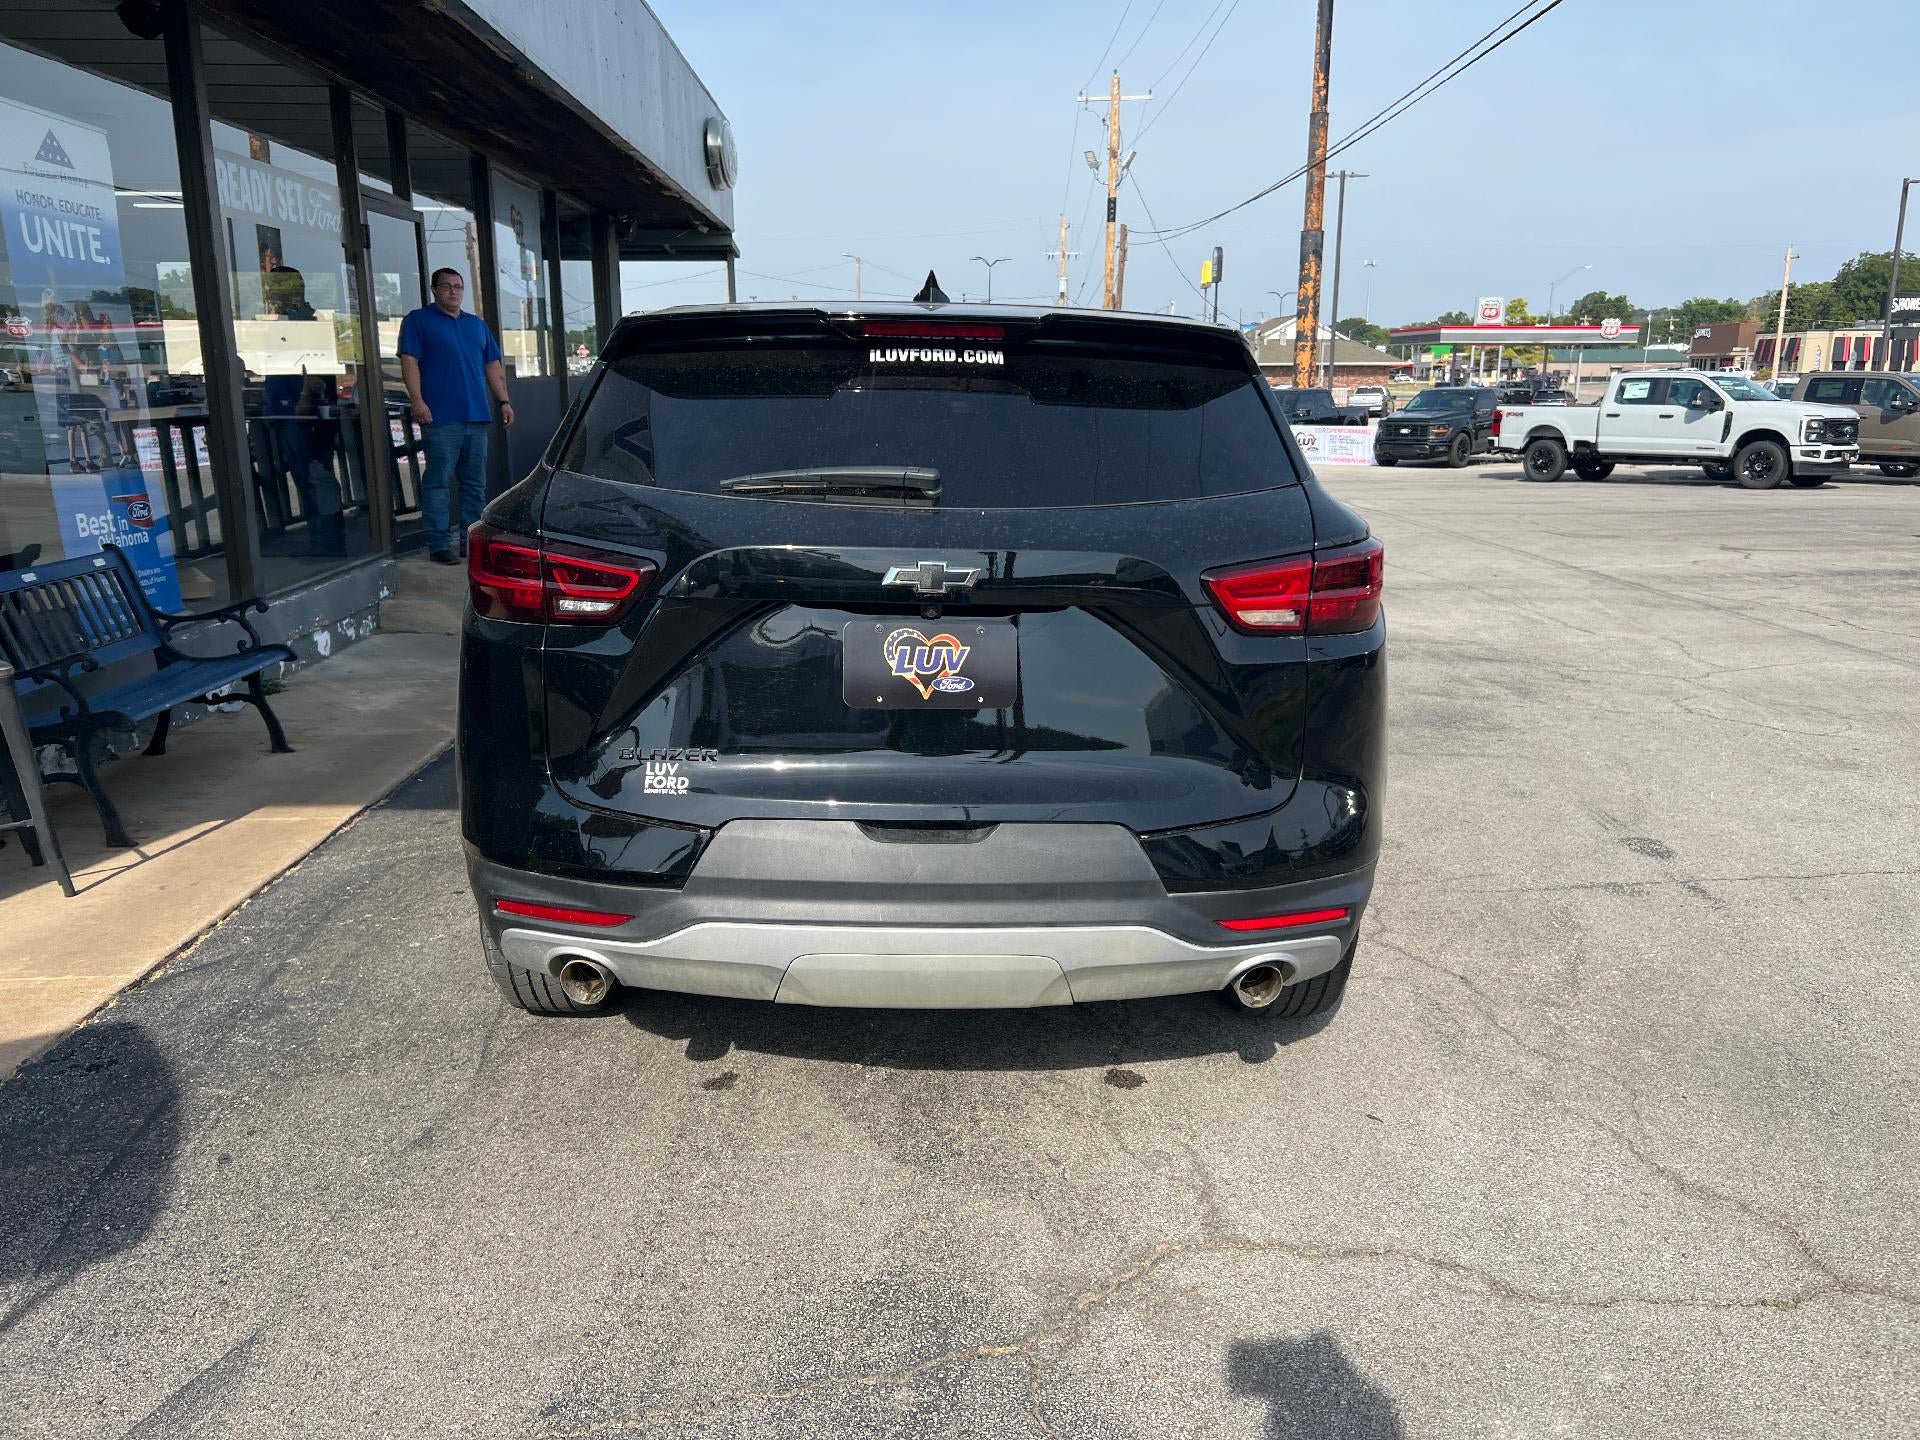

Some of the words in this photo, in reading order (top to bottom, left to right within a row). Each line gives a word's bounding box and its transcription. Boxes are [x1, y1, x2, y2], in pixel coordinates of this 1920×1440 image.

[214, 160, 273, 216] READY
[275, 177, 304, 224] SET
[20, 213, 111, 265] UNITE.
[131, 503, 150, 518] Ford
[75, 510, 116, 537] Best
[118, 515, 129, 531] in
[892, 646, 970, 675] LUV
[938, 677, 968, 691] Ford
[619, 748, 718, 761] BLAZER
[646, 761, 680, 776] LUV
[644, 775, 690, 789] FORD
